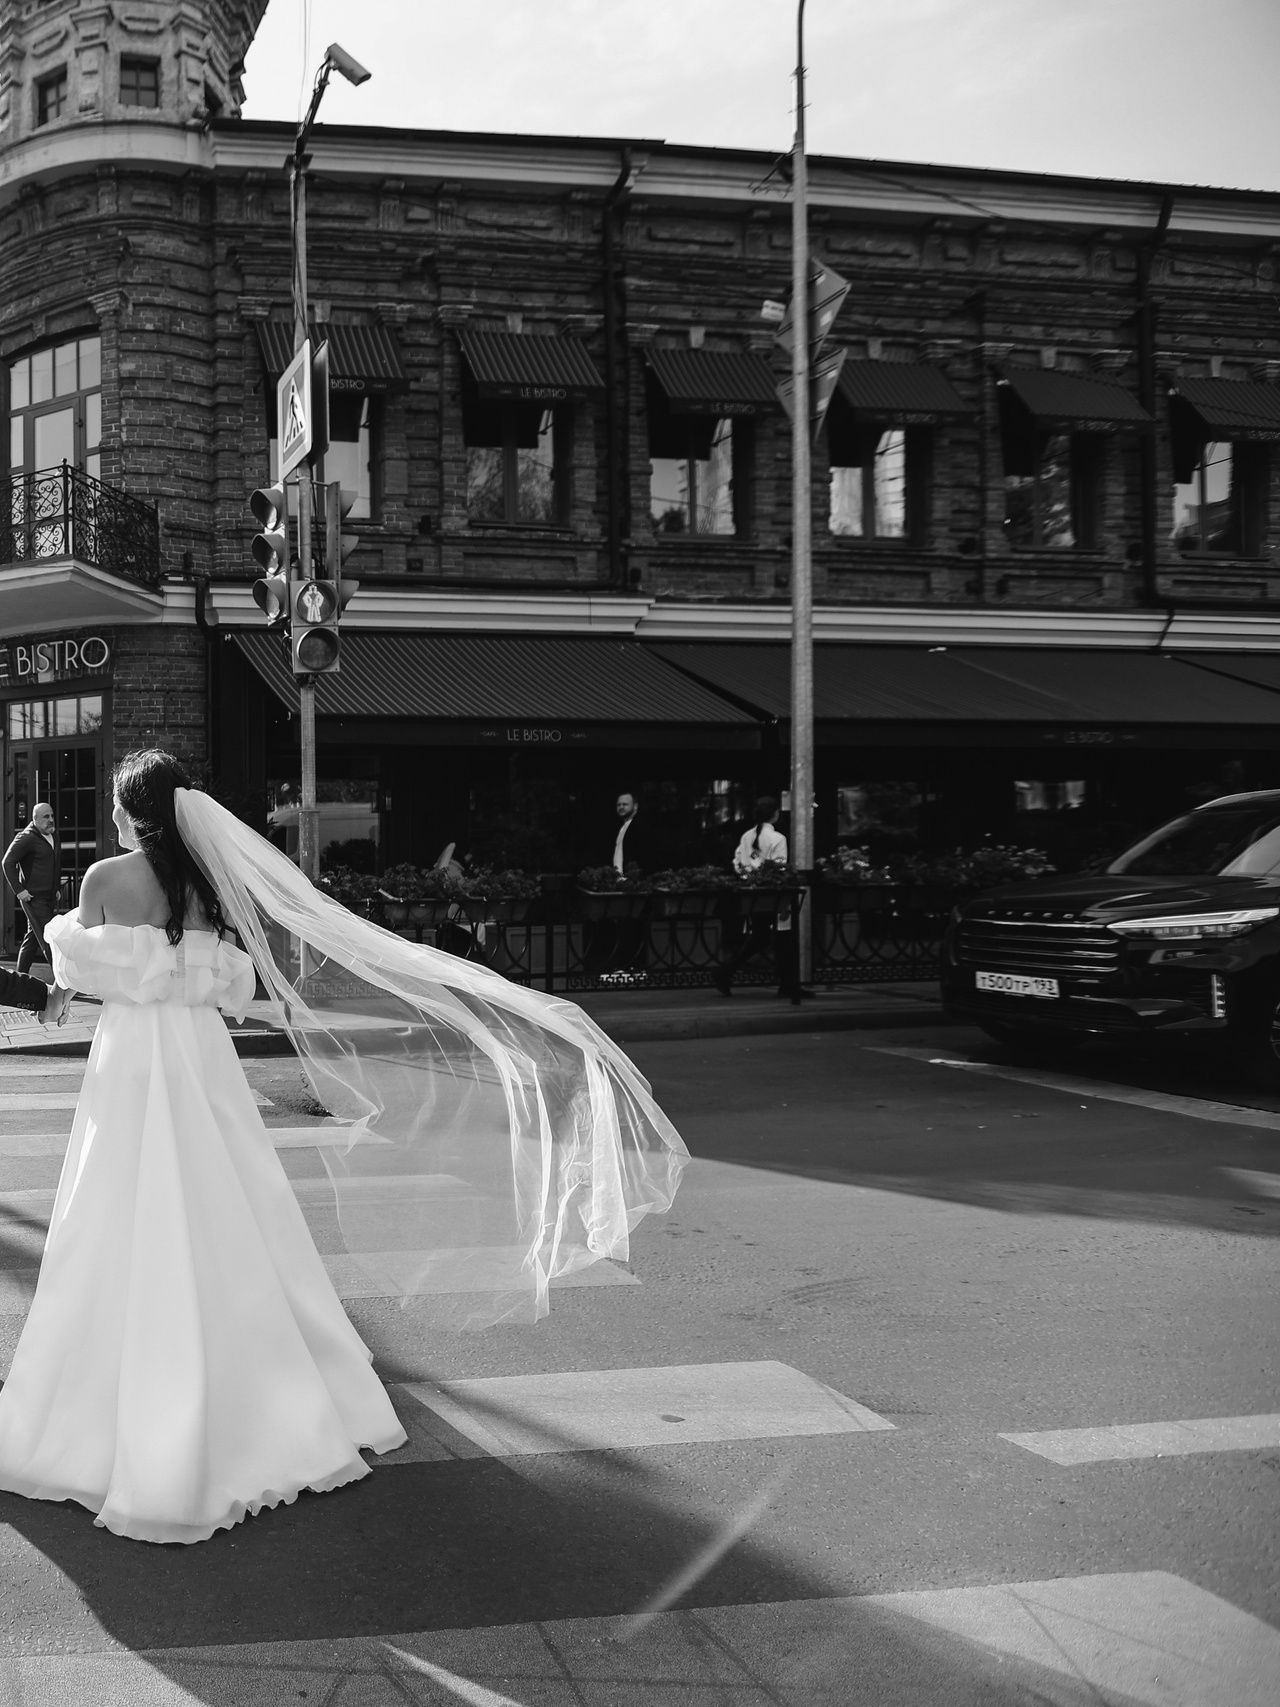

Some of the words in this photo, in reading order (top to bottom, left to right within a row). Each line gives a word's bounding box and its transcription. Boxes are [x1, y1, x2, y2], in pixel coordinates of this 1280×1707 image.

[330, 379, 365, 390] BISTRO
[520, 387, 532, 398] LE
[534, 387, 567, 399] BISTRO
[16, 637, 109, 676] BISTRO
[507, 729, 520, 741] LE
[523, 729, 562, 742] BISTRO
